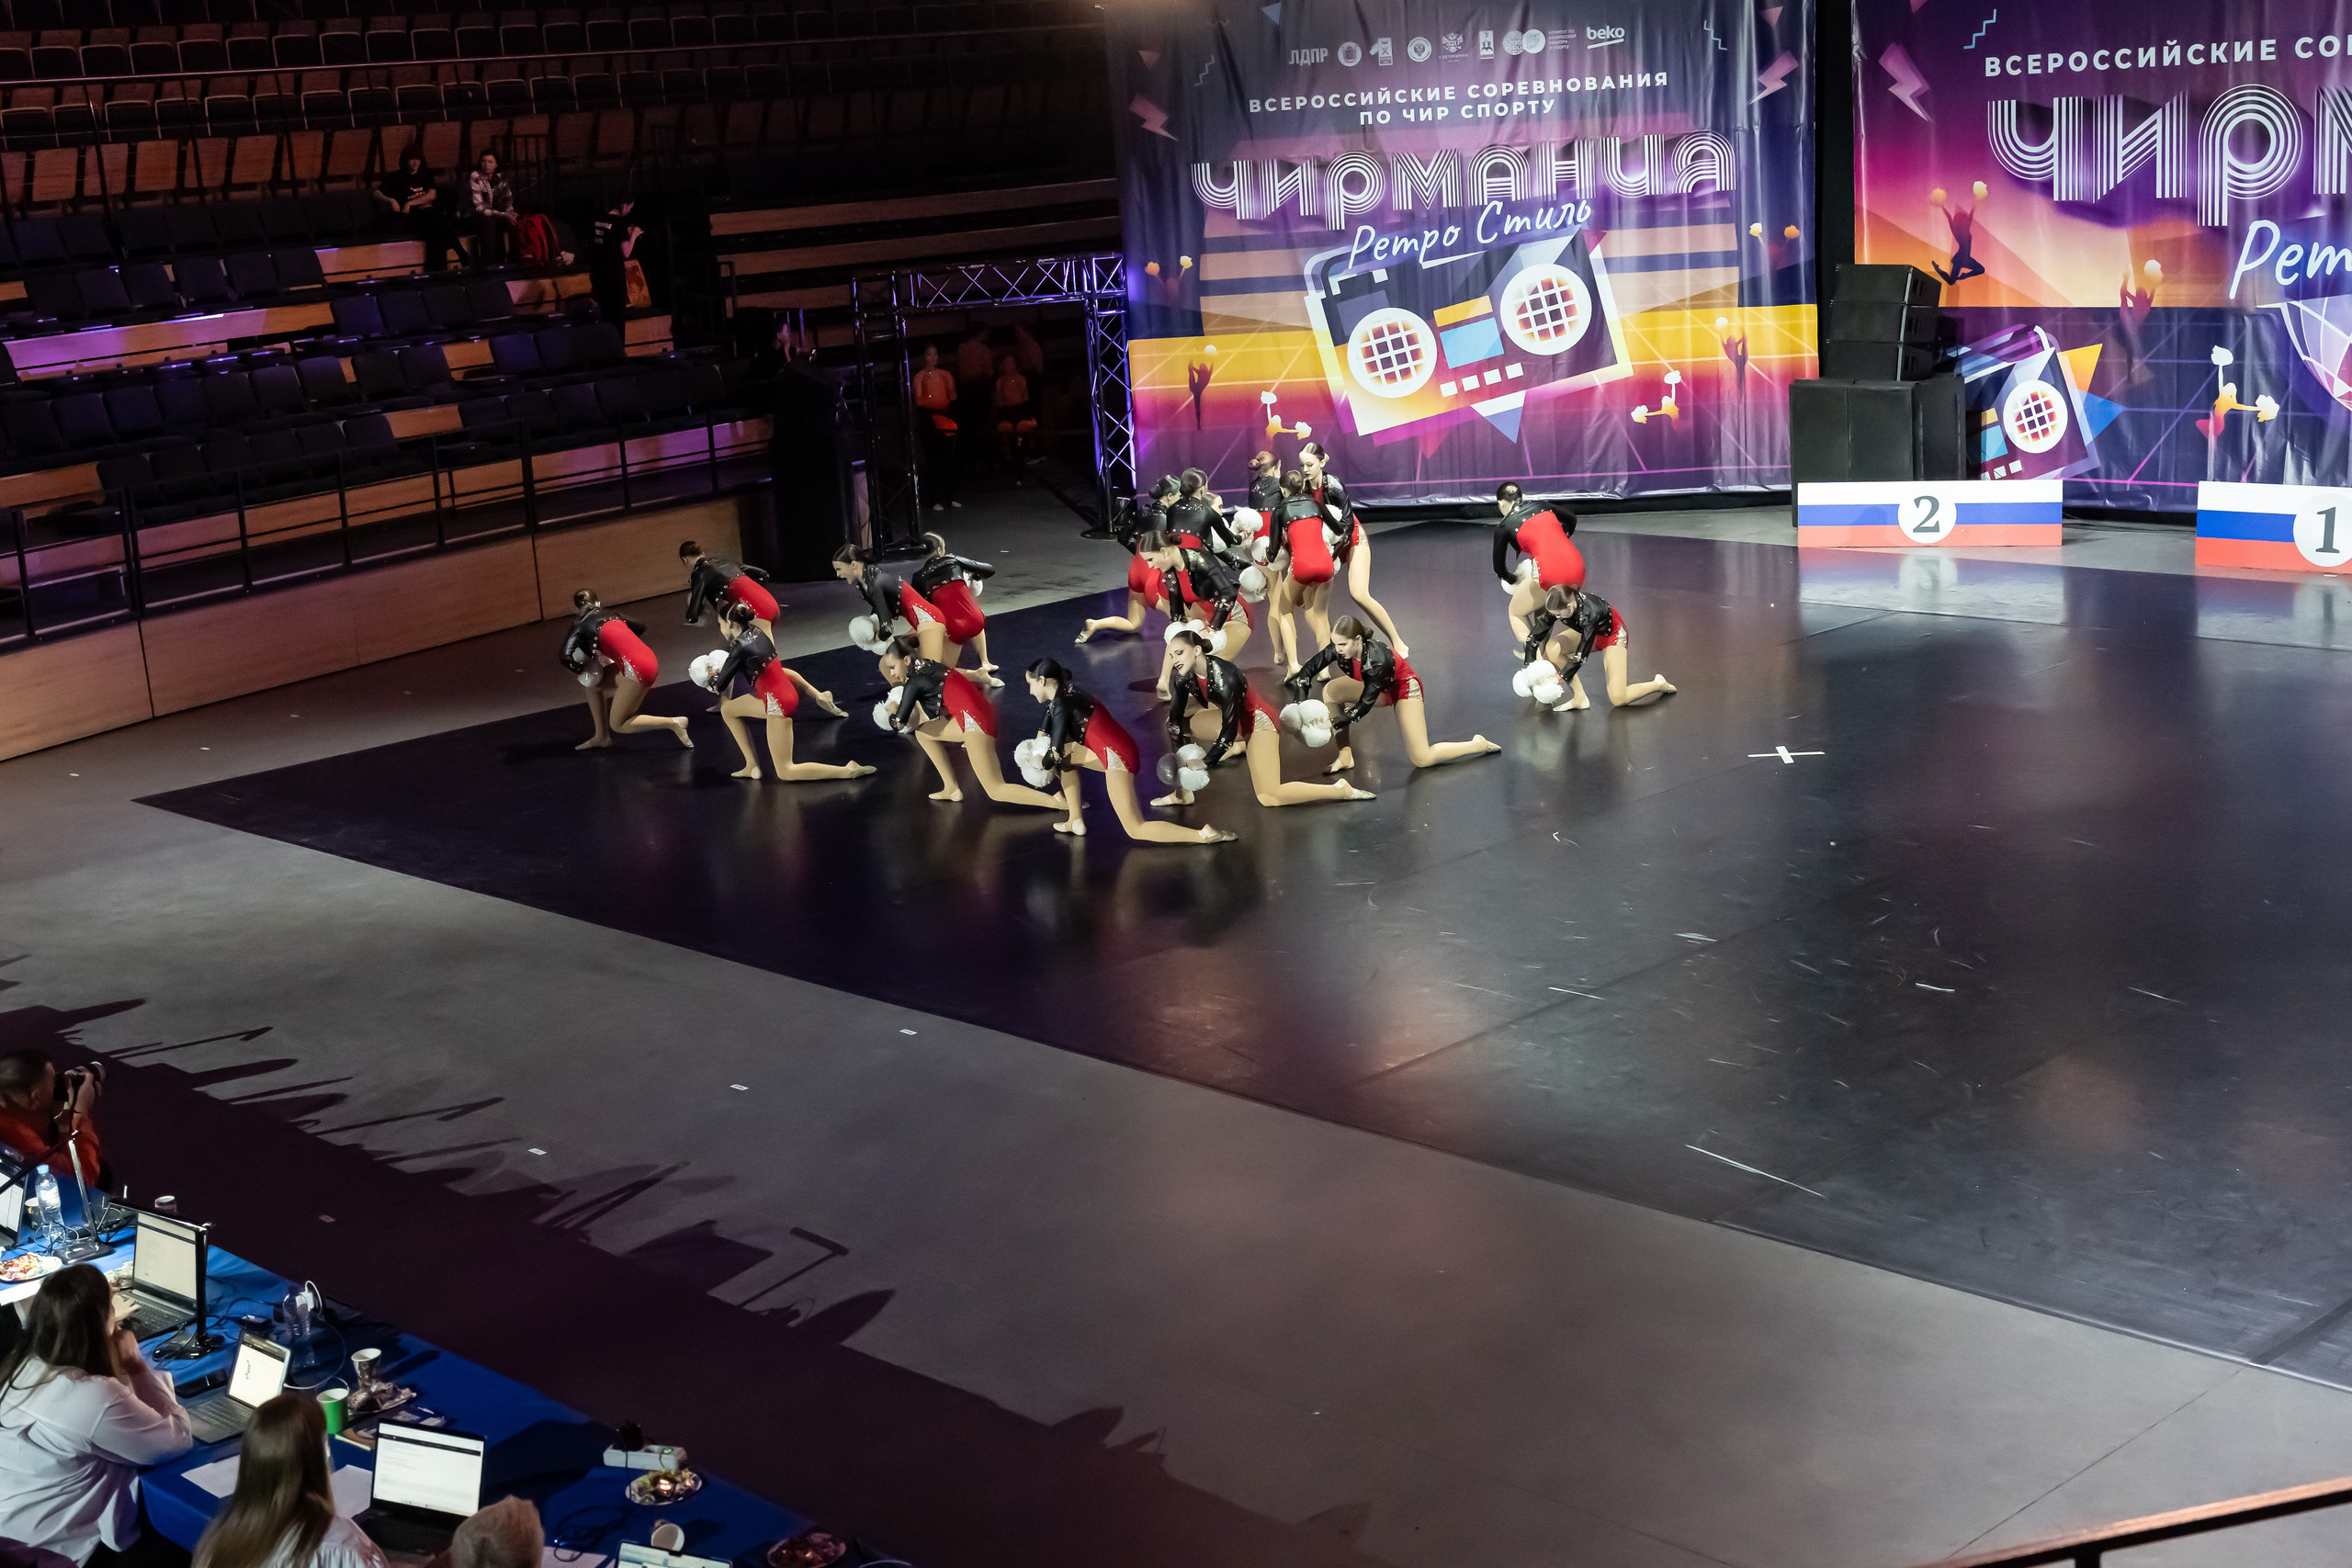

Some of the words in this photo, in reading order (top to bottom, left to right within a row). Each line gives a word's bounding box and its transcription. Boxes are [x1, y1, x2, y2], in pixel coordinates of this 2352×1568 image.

[1586, 26, 1625, 40] beko
[1289, 48, 1329, 66] ЛДПР
[1985, 39, 2277, 77] ВСЕРОССИЙСКИЕ
[1249, 85, 1456, 113] ВСЕРОССИЙСКИЕ
[1467, 72, 1668, 99] СОРЕВНОВАНИЯ
[1360, 110, 1391, 126] ПО
[1402, 107, 1450, 122] ЧИР
[1461, 99, 1555, 118] СПОРТУ
[1348, 225, 1462, 270] Ретро
[1476, 199, 1592, 244] Стиль
[1913, 495, 1940, 533] 2
[2315, 507, 2340, 554] 1
